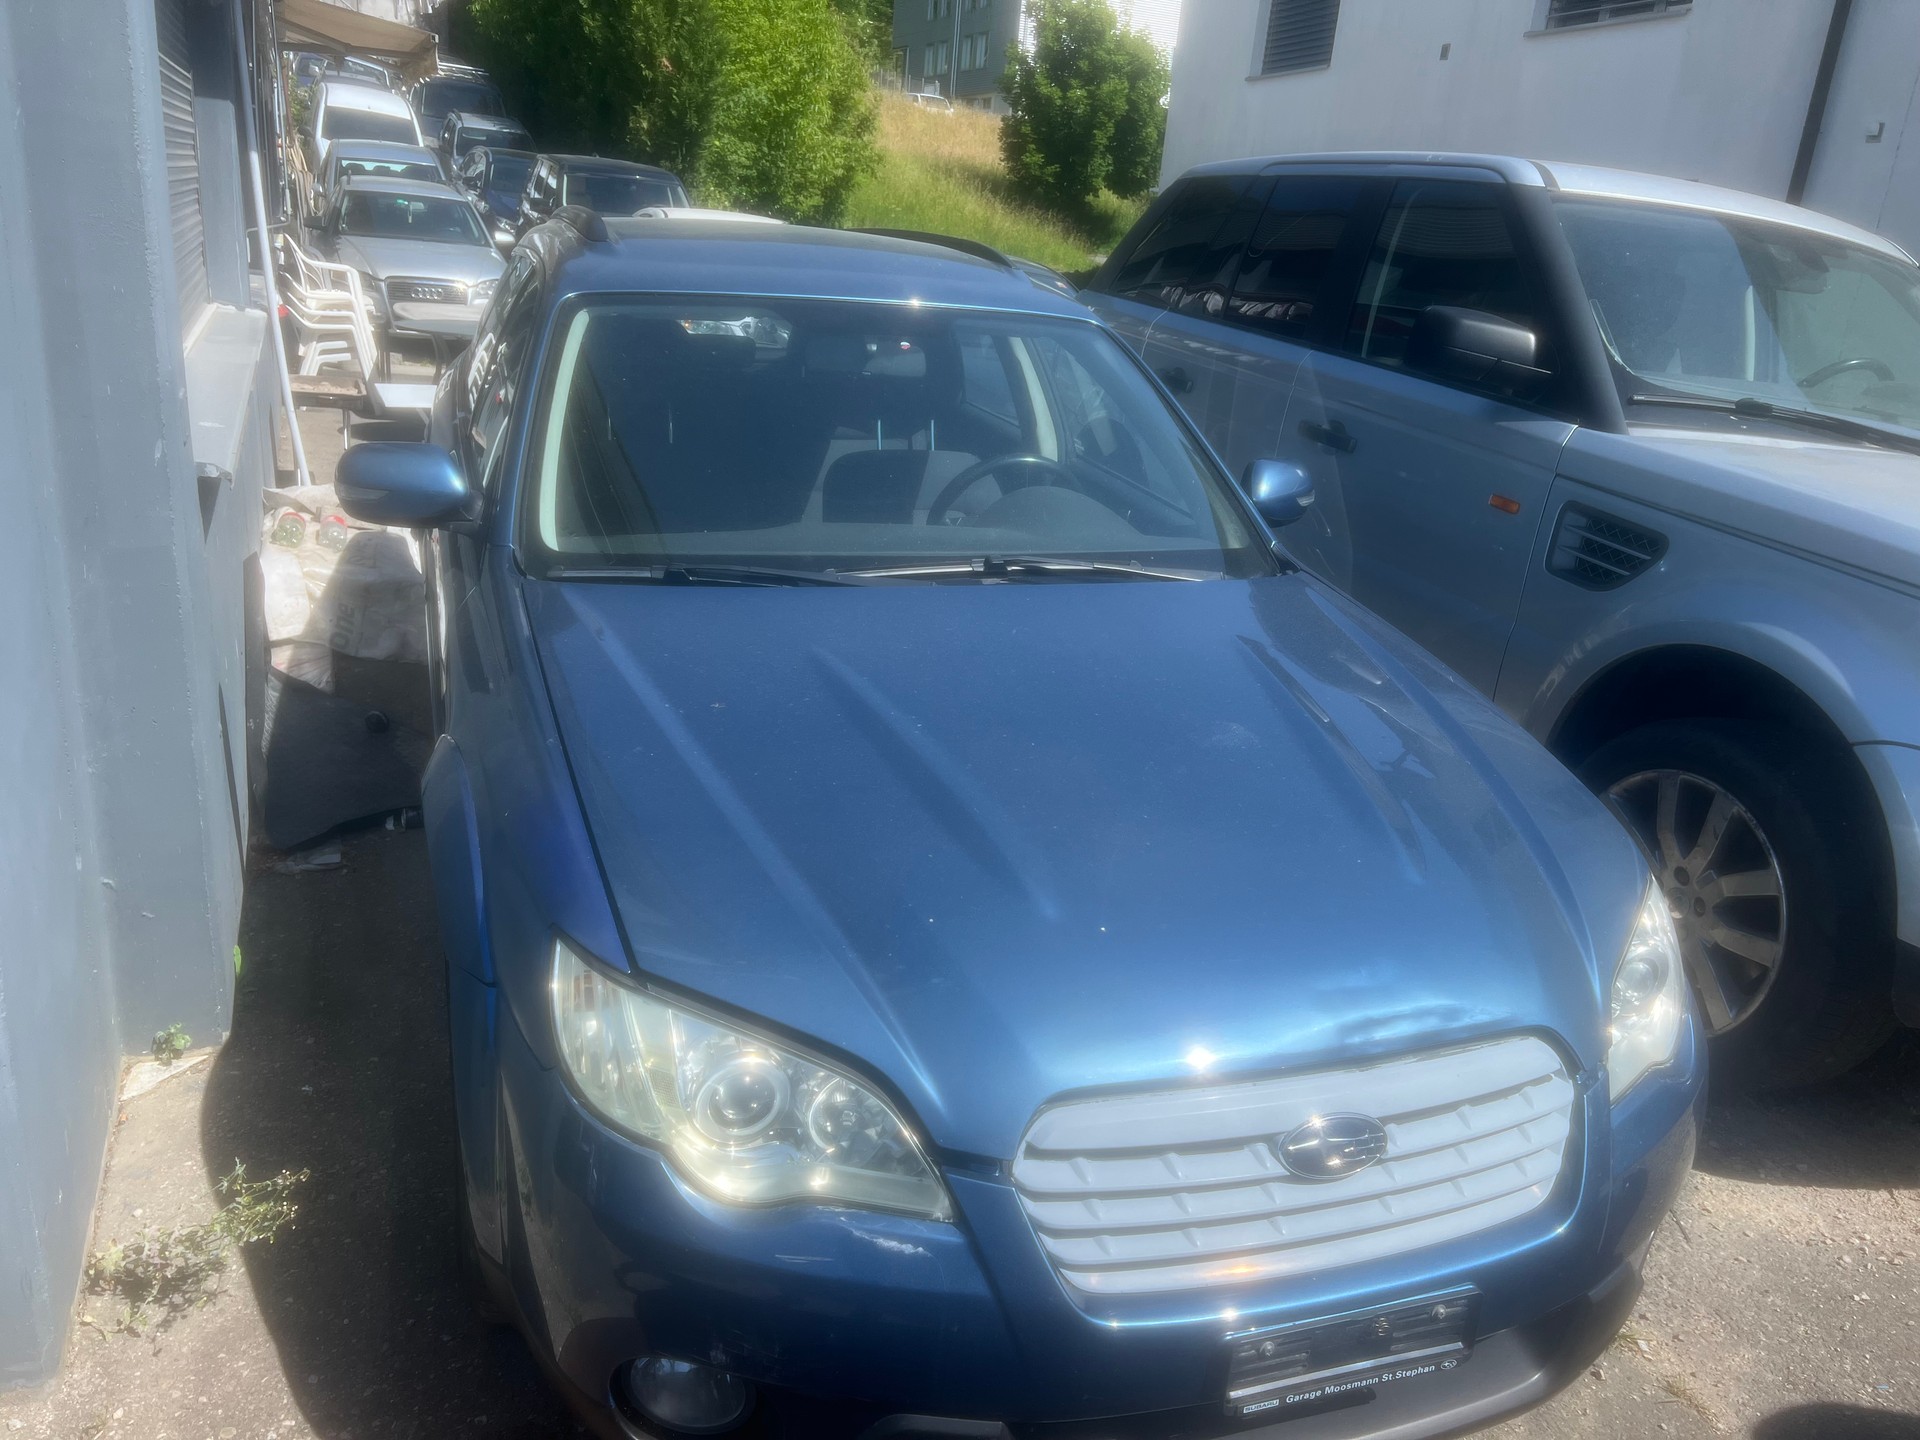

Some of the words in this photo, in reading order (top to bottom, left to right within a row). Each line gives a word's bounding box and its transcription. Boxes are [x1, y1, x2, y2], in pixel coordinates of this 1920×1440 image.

[1286, 1390, 1322, 1403] Garage
[1324, 1377, 1379, 1394] Moosmann
[1244, 1400, 1279, 1413] SUBARU
